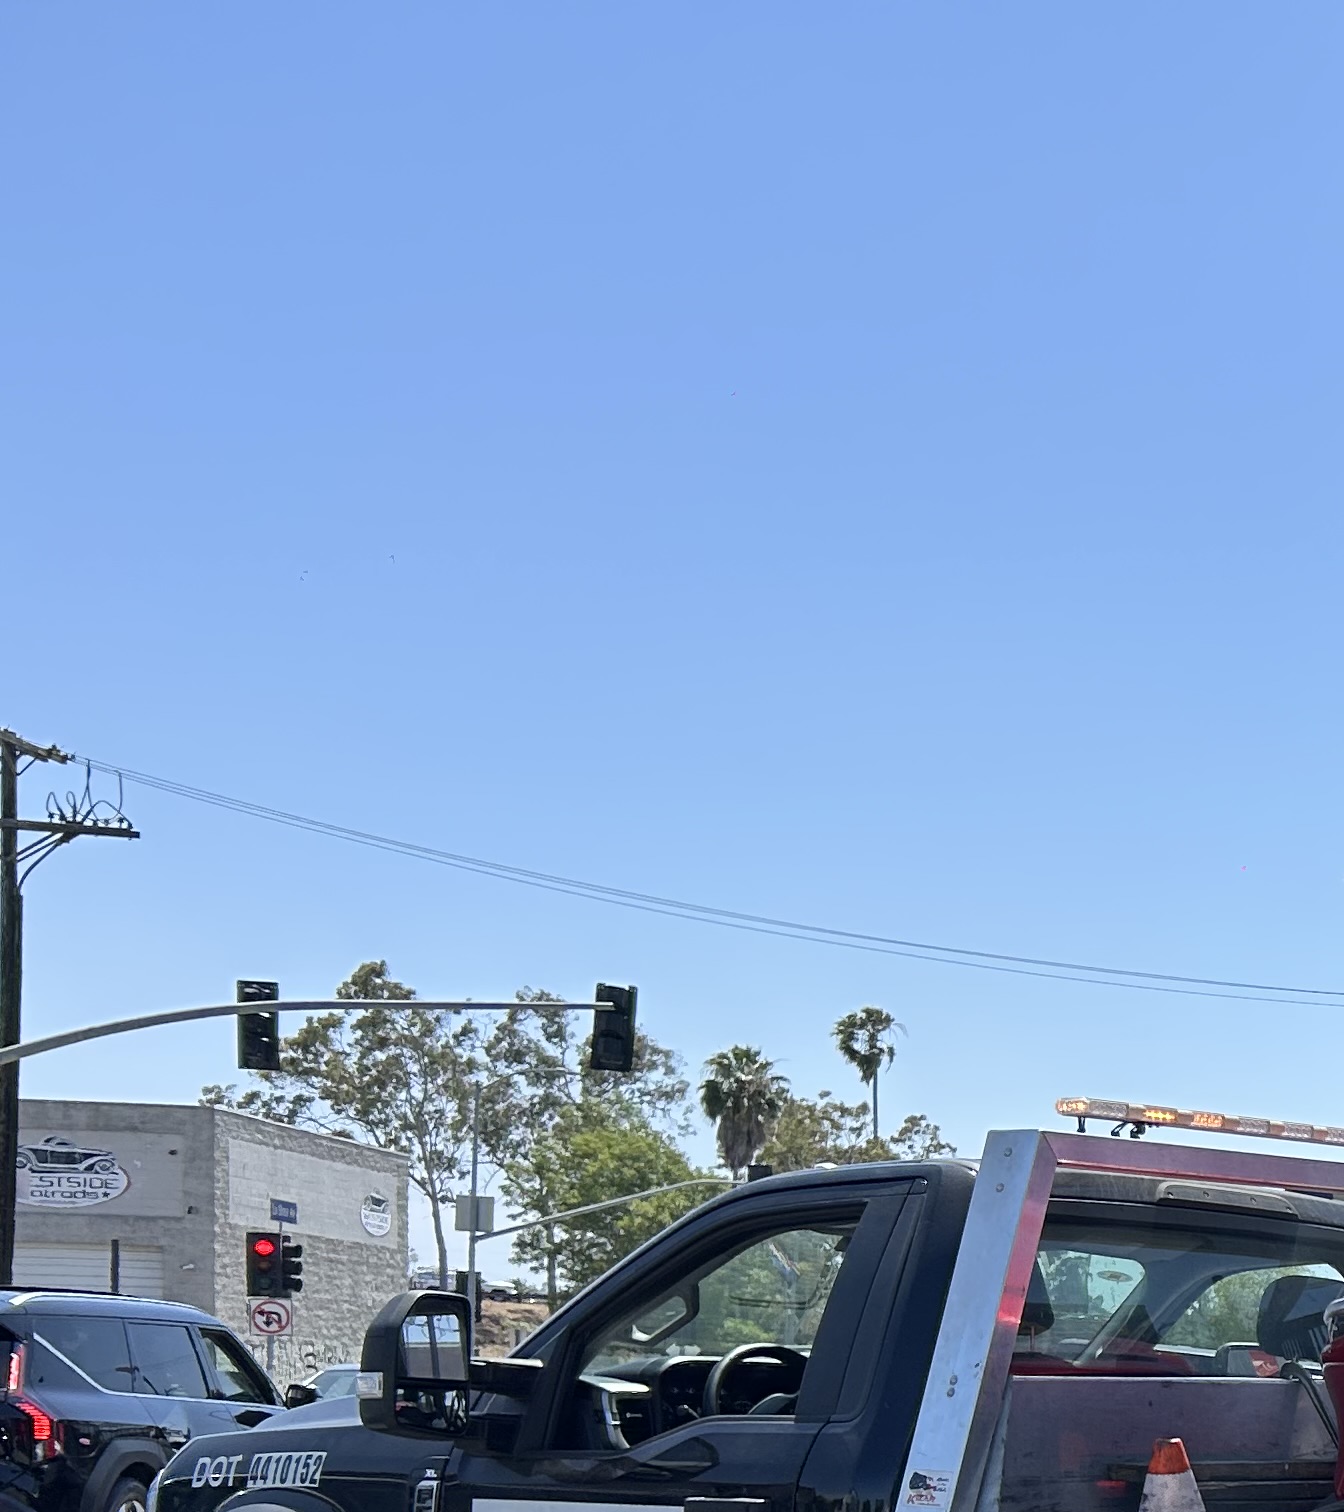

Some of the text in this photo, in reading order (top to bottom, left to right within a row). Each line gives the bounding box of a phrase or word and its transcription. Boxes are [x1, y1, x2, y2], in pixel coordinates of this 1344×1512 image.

[31, 1176, 120, 1189] ESTSIDE
[30, 1190, 99, 1199] otrods
[191, 1454, 324, 1488] DOT 4410152
